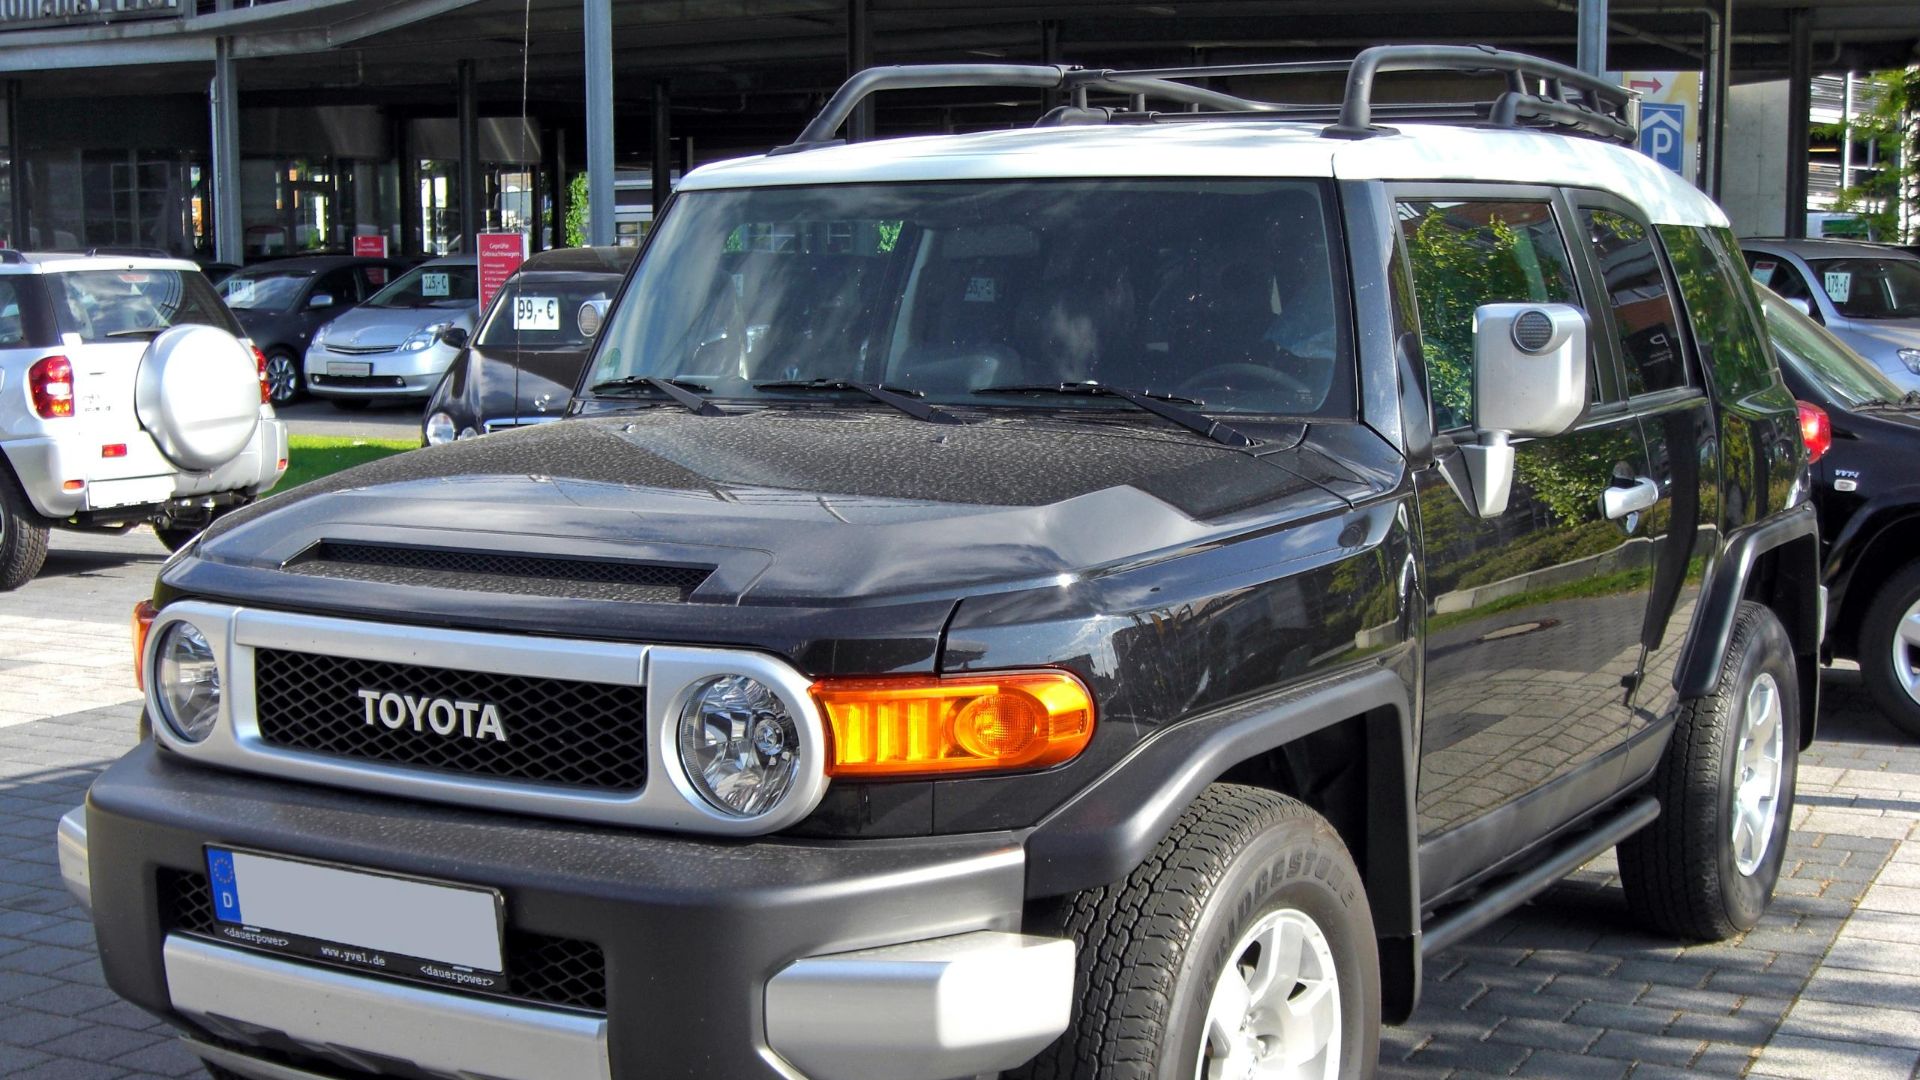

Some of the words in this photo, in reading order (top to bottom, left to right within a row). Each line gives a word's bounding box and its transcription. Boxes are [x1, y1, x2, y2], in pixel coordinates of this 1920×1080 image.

[1652, 127, 1673, 162] P
[547, 299, 555, 320] €
[358, 689, 507, 742] TOYOTA
[222, 892, 233, 908] D
[321, 946, 386, 966] www.yvel.de
